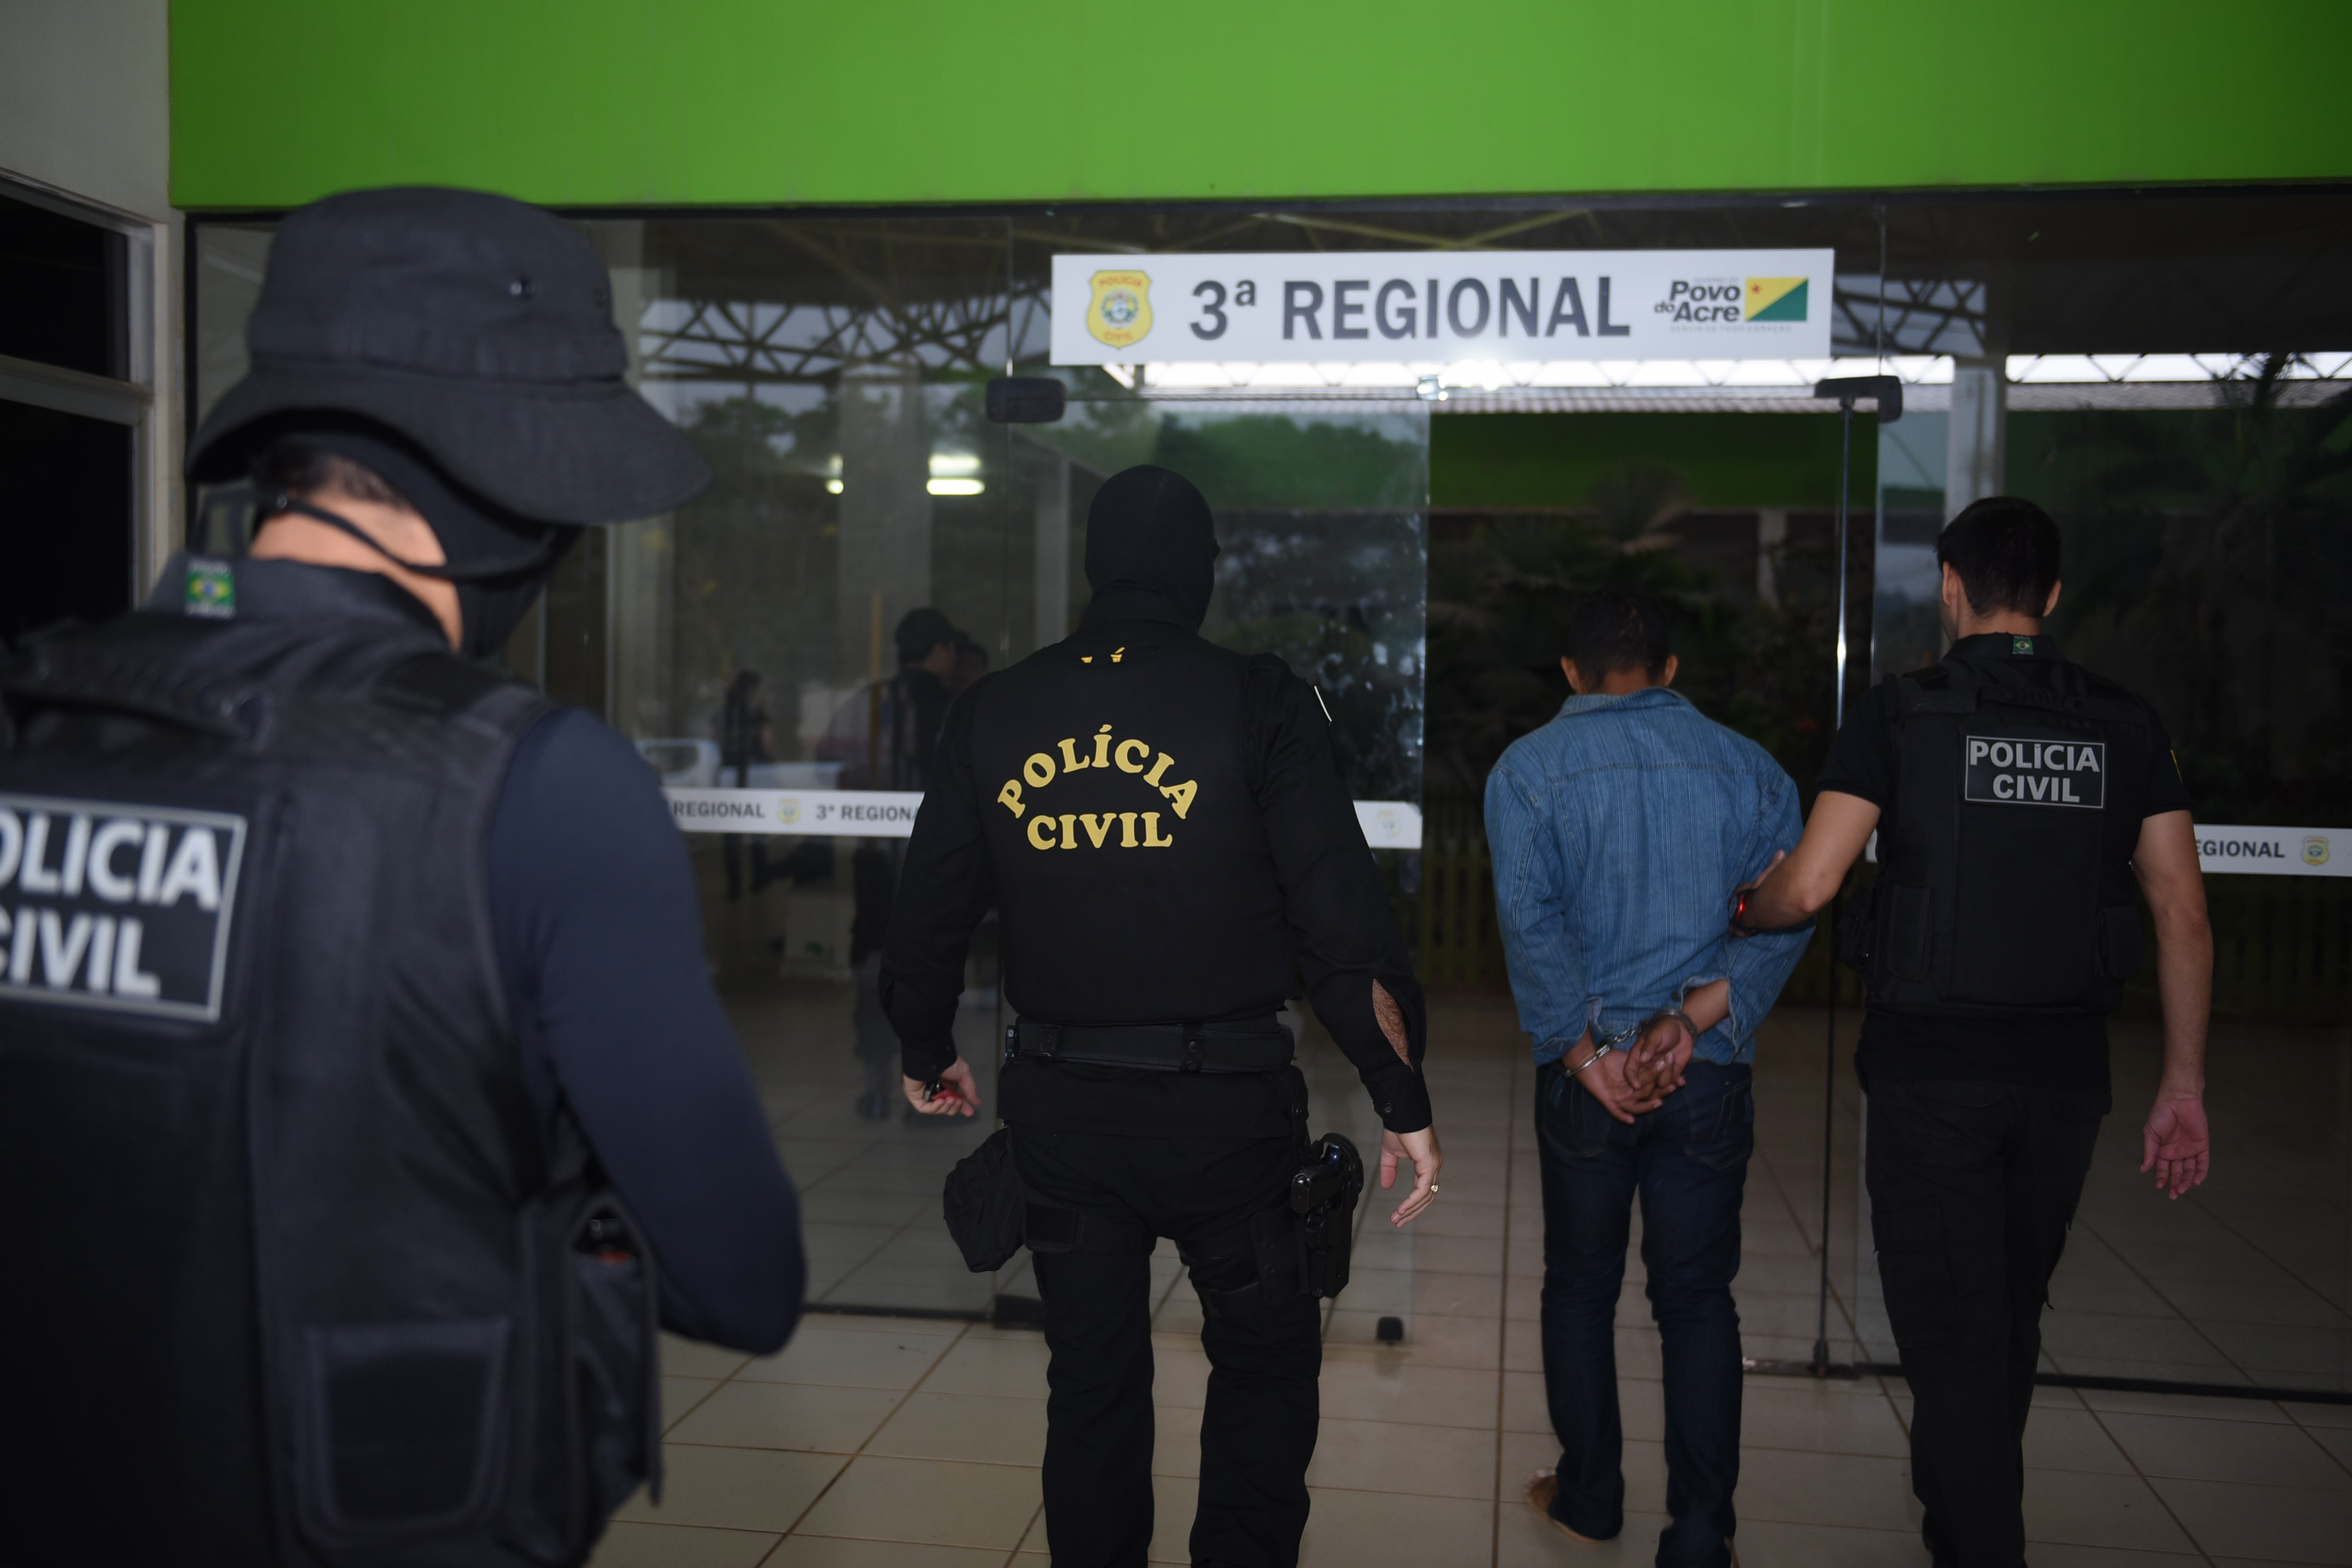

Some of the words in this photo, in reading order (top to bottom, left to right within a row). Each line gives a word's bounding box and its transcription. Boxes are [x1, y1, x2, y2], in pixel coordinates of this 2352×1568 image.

[1670, 280, 1741, 301] Povo
[1282, 276, 1631, 340] REGIONAL
[1654, 300, 1675, 313] do
[1673, 301, 1740, 322] Acre
[997, 724, 1198, 820] POLÍCIA
[1993, 774, 2080, 803] CIVIL
[673, 801, 765, 818] REGIONAL
[1027, 812, 1173, 850] CIVIL
[0, 903, 161, 998] IVIL
